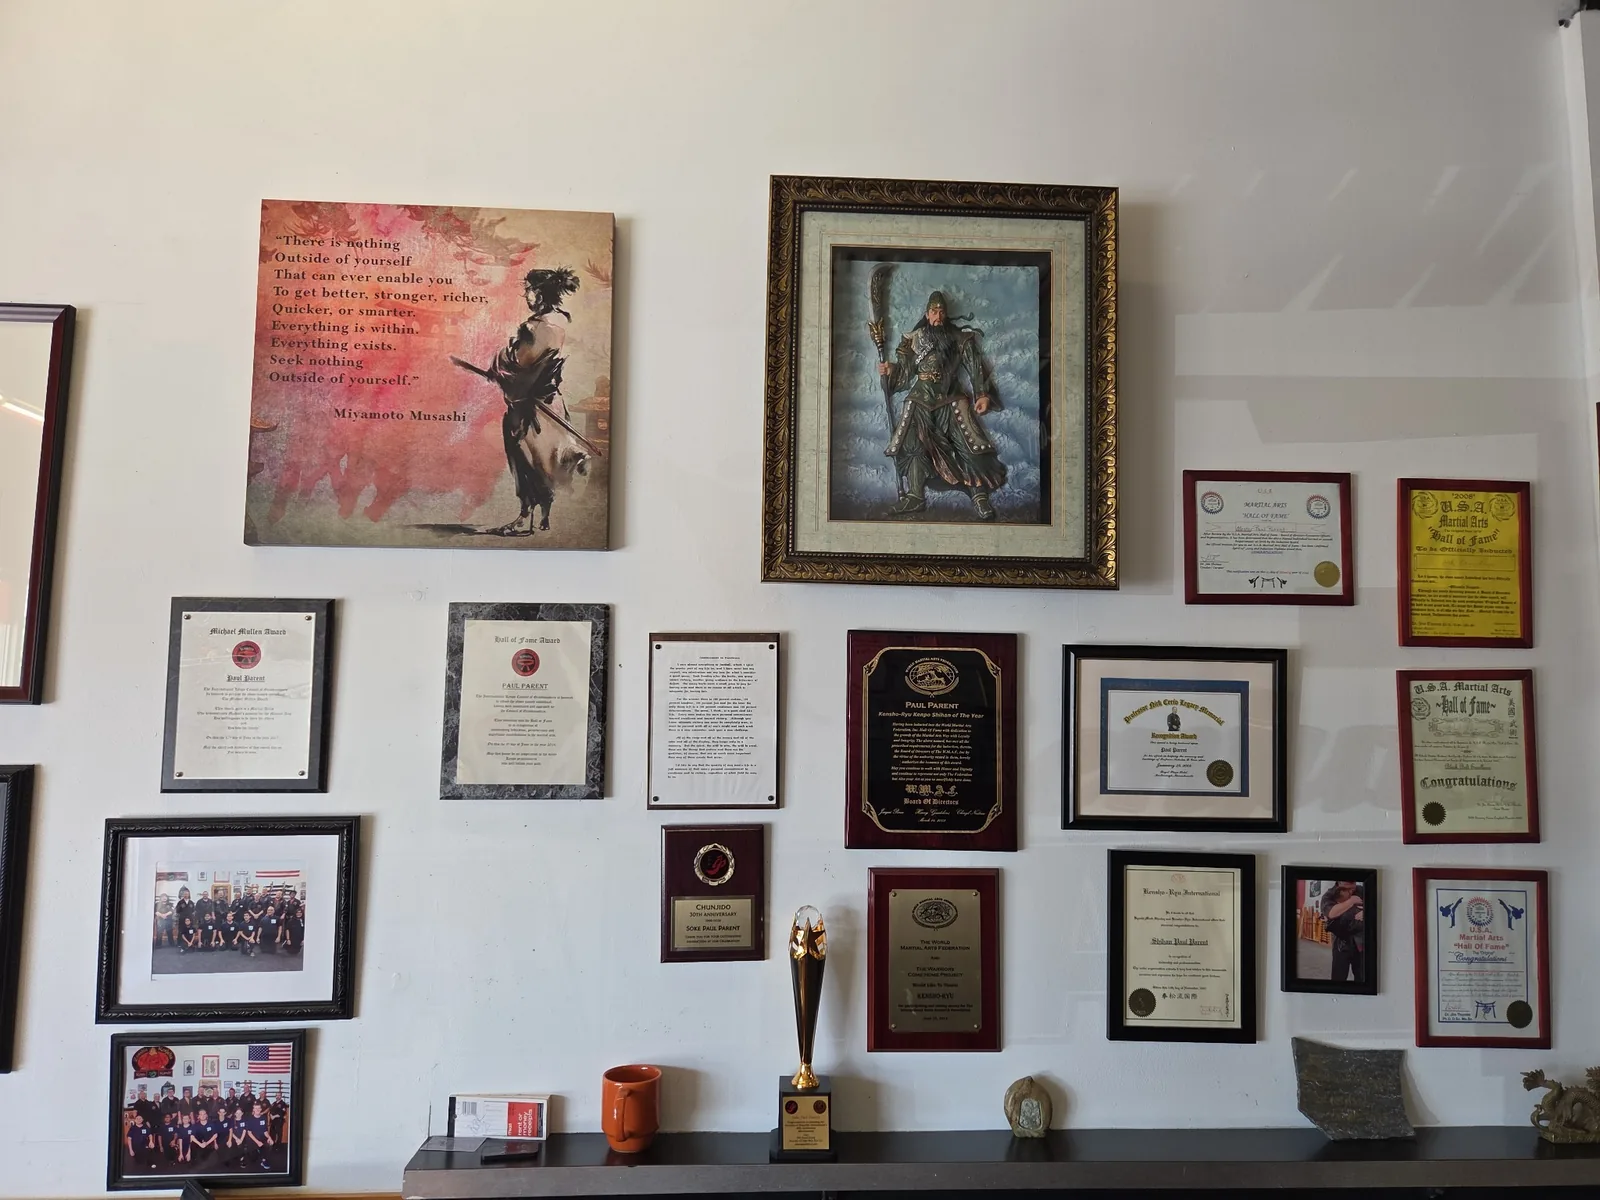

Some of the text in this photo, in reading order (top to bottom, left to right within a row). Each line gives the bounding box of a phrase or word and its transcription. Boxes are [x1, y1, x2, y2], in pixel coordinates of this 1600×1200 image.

[331, 238, 340, 246] is
[347, 238, 400, 252] nothing
[275, 252, 412, 267] Outside of yourself
[274, 269, 306, 280] That
[377, 273, 423, 283] enable
[428, 277, 452, 287] you
[274, 286, 488, 304] To get better, stronger, richer,
[272, 304, 332, 315] Quicker,
[359, 308, 415, 317] smarter.
[272, 320, 418, 335] Everything is within.
[271, 338, 396, 352] Everything exists.
[270, 355, 363, 369] Seek nothing
[270, 372, 324, 383] Outside
[330, 373, 345, 384] of
[334, 408, 466, 422] Miyamoto Musashi
[1441, 501, 1487, 514] U.S.A.
[1439, 515, 1488, 528] Martial Arts
[1414, 682, 1512, 696] U.S.A. Martial Arts
[1460, 697, 1467, 713] of
[1199, 706, 1225, 726] Memorial
[1420, 775, 1517, 791] Congratulations
